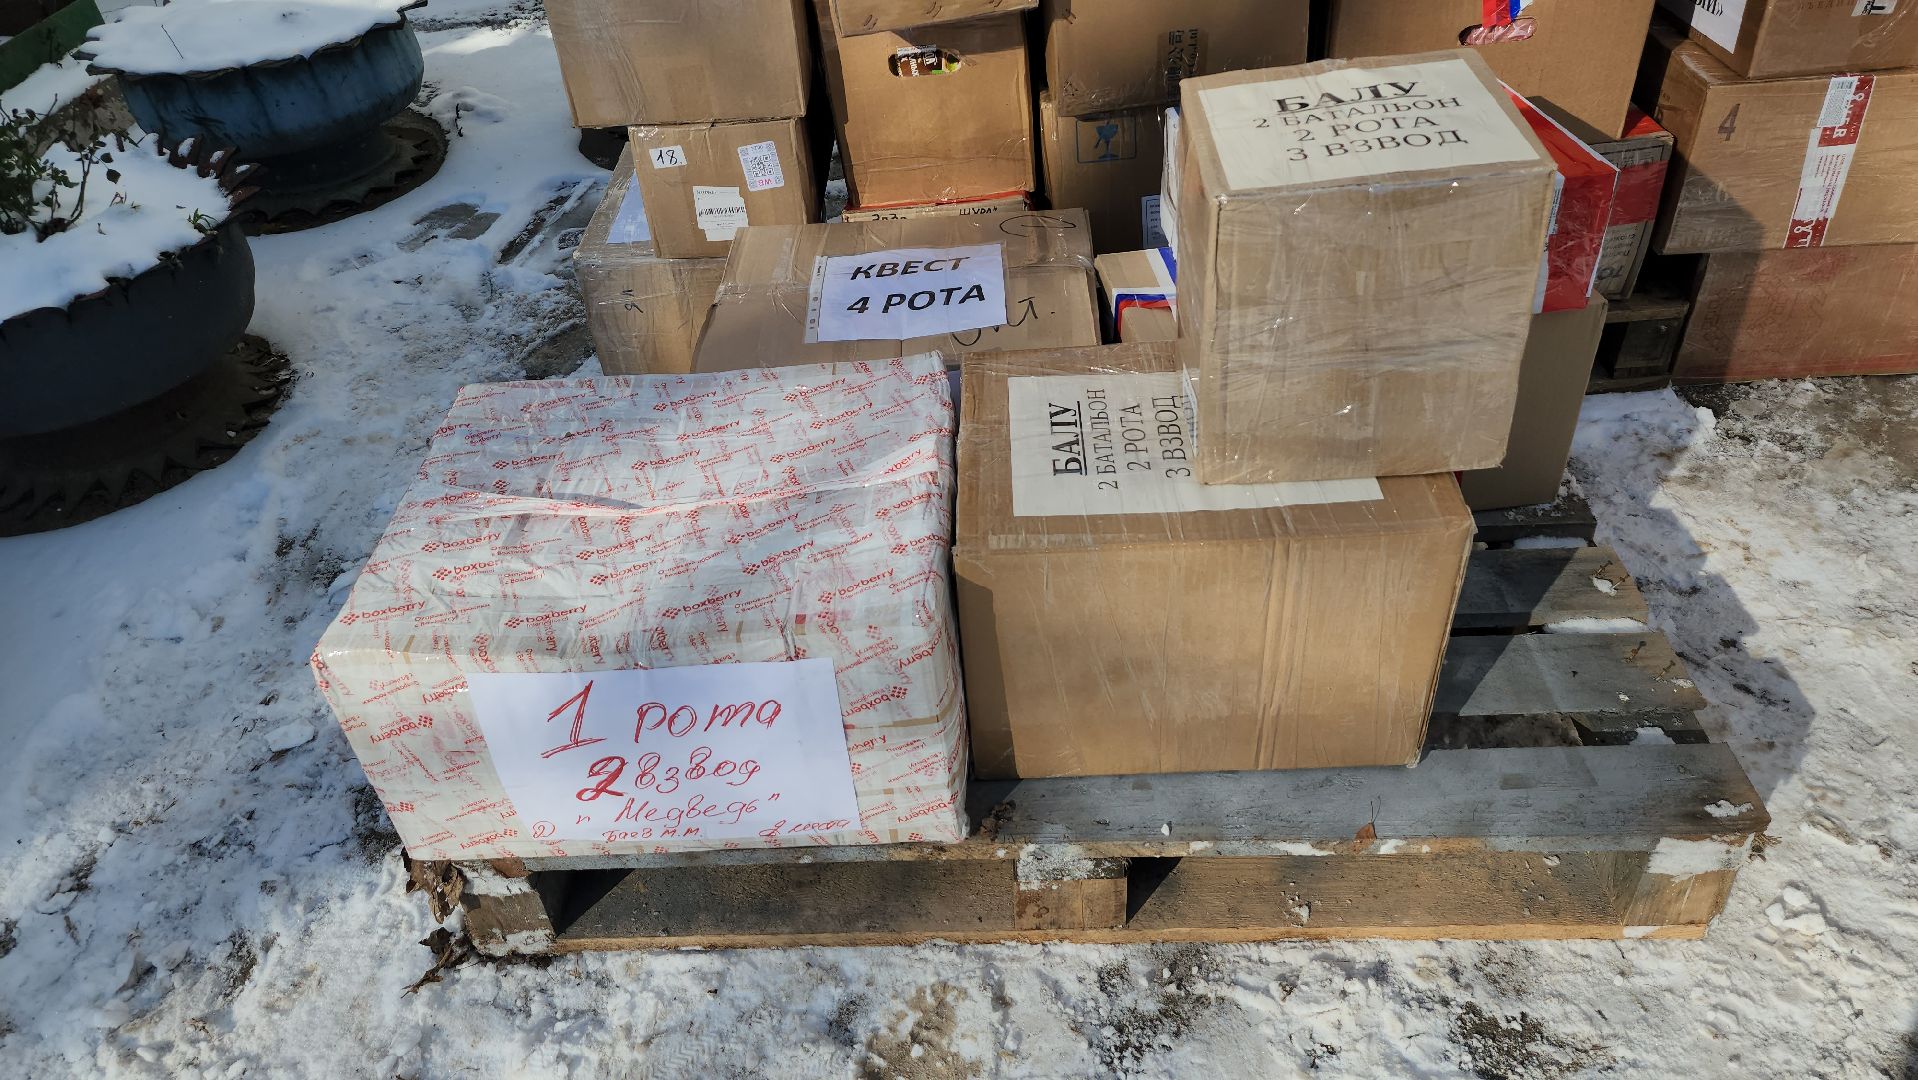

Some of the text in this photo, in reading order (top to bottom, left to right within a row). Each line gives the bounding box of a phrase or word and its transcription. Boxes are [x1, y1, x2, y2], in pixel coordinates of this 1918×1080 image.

[1273, 81, 1418, 113] БАЛУ
[1253, 97, 1464, 128] 2 БАТАЛЬОН
[1717, 103, 1741, 142] 4
[1293, 116, 1440, 142] 2 РОТА
[1286, 129, 1469, 161] 3 ВЗВОД
[851, 256, 970, 281] КВЕСТ
[847, 284, 986, 314] 4 РОТА
[799, 377, 846, 397] boxberry
[1049, 402, 1083, 476] БАЛУ
[1087, 388, 1119, 490] 2 БАТАЛЬОН
[1119, 403, 1152, 471] 2 РОТА
[1152, 395, 1187, 461] ВЗВОД
[650, 449, 700, 466] boxberry
[786, 437, 836, 458] boxberry
[1165, 467, 1191, 479] 3
[747, 511, 799, 538] boxberry
[442, 531, 501, 550] boxberry
[760, 539, 815, 567] boxberry
[837, 567, 895, 596] boxberry
[361, 600, 427, 619] boxberry
[525, 604, 588, 624] boxberry
[682, 588, 742, 613] boxberry
[541, 679, 782, 759] 1 рота
[369, 721, 418, 745] boxberry
[575, 746, 761, 802] 2 взвод
[896, 802, 948, 824] boxberry
